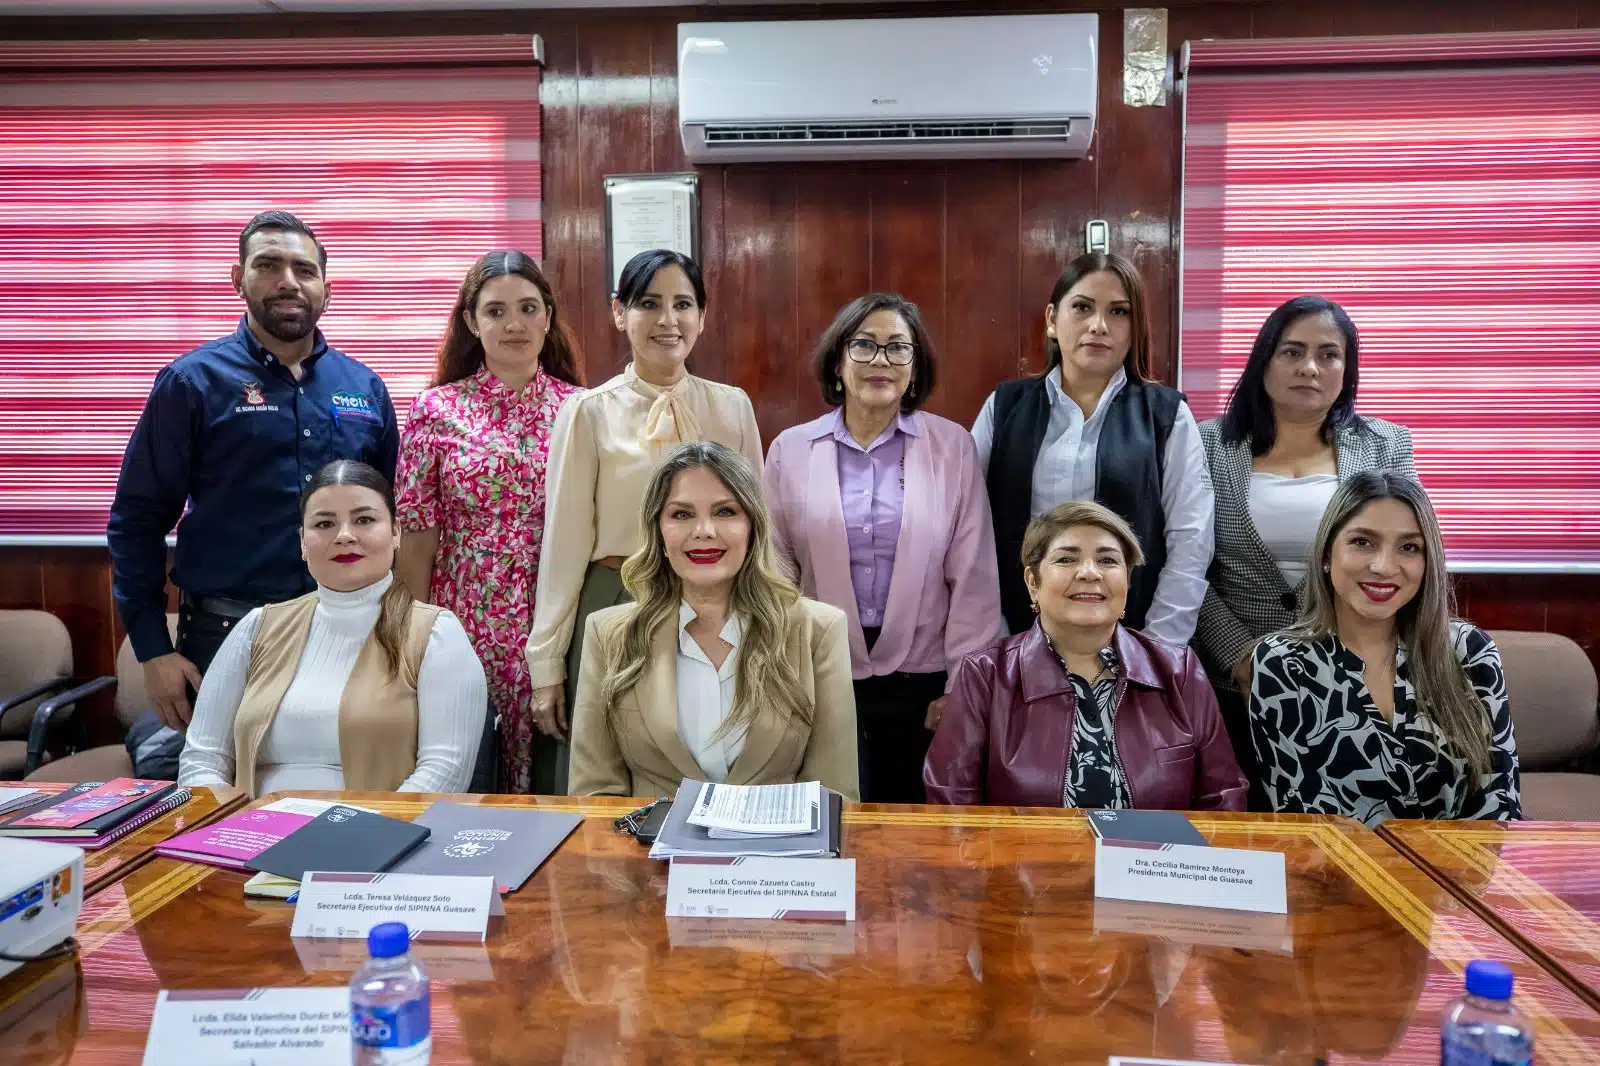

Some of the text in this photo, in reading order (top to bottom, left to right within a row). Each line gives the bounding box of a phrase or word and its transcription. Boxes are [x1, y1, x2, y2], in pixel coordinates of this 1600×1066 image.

[1135, 859, 1151, 867] Dra.
[1152, 860, 1178, 869] Cecilia
[1212, 865, 1245, 876] Montoya
[1128, 867, 1253, 885] Presidenta Municipal de Guasave
[709, 878, 815, 888] Lcda. Connie Zazueta Castro
[727, 887, 762, 897] Ejecutiva
[763, 888, 775, 896] del
[776, 889, 809, 897] SIPINNA
[810, 889, 837, 898] Estatal
[344, 893, 451, 904] Lcda. Teresa Velázquez Soto
[357, 903, 393, 913] Ejecutiva
[394, 904, 407, 912] del
[408, 904, 441, 913] SIPINNA
[443, 905, 476, 914] Guasave
[250, 1011, 297, 1022] Valentina
[254, 1026, 300, 1038] Ejecutiva
[302, 1024, 319, 1035] del
[232, 1038, 325, 1050] Salvador Alvarado
